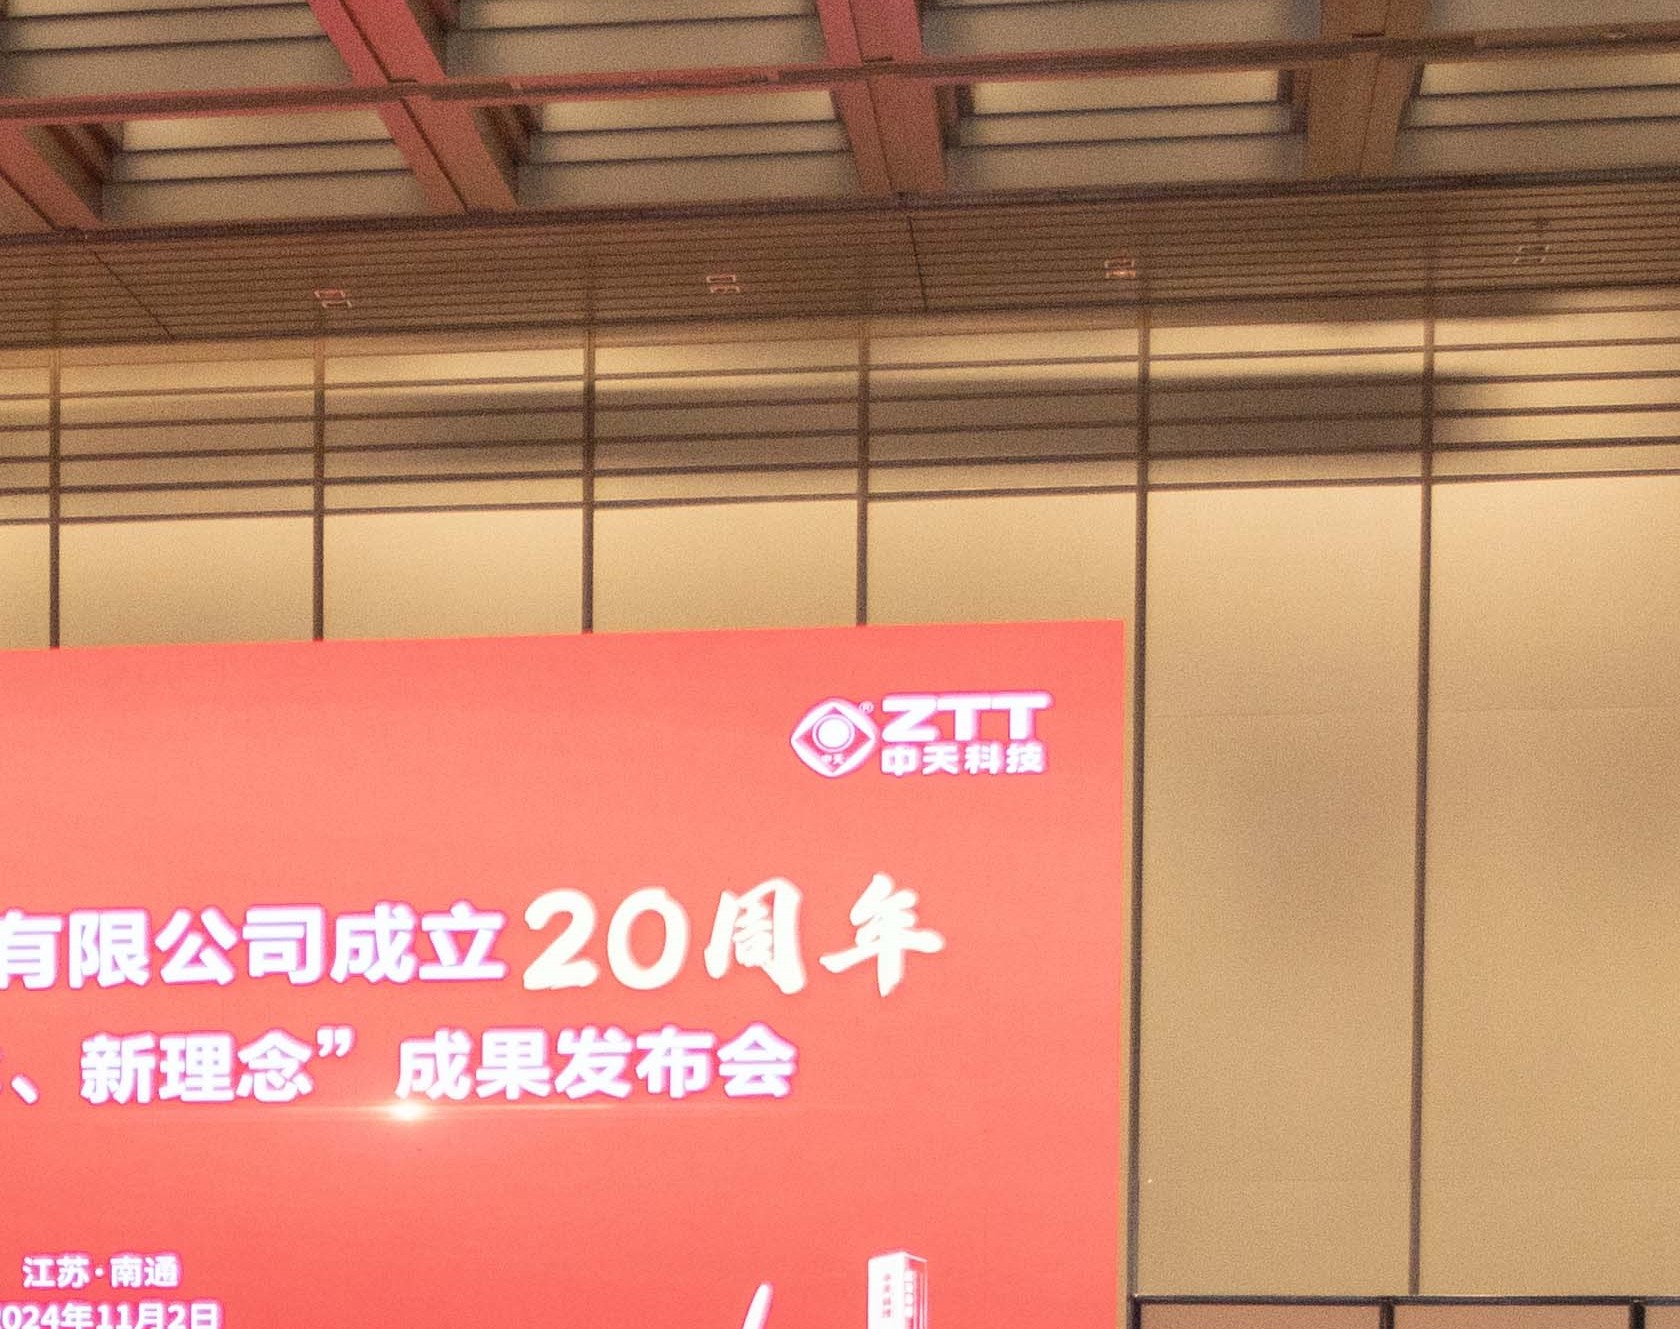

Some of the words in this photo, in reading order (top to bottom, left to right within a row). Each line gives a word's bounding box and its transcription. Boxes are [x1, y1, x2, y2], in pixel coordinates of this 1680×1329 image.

[882, 693, 1051, 741] ZTT
[882, 743, 1044, 776] 中天科技
